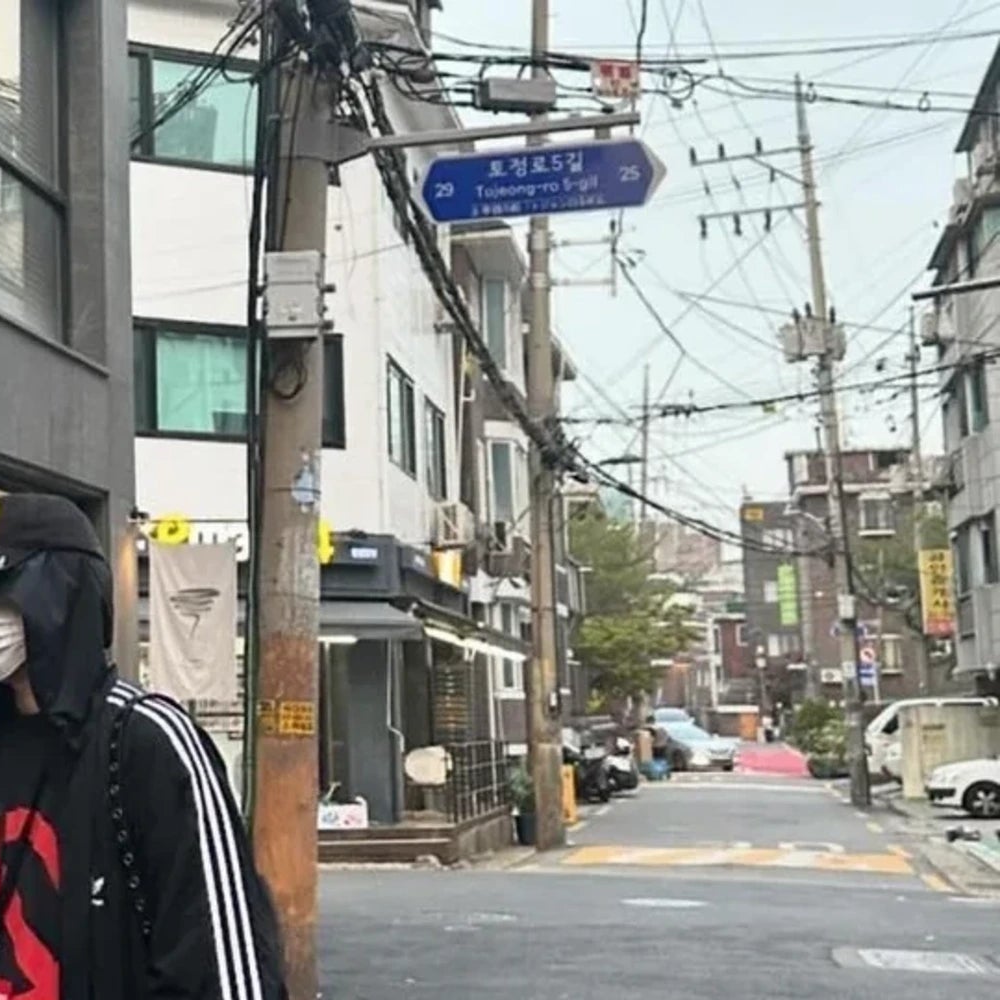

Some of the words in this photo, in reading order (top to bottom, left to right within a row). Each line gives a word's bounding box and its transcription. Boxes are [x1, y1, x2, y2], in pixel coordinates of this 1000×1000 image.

[487, 151, 583, 178] 토정로5길
[618, 165, 641, 182] 25
[434, 181, 454, 198] 29
[475, 179, 560, 199] Tojeong-ro
